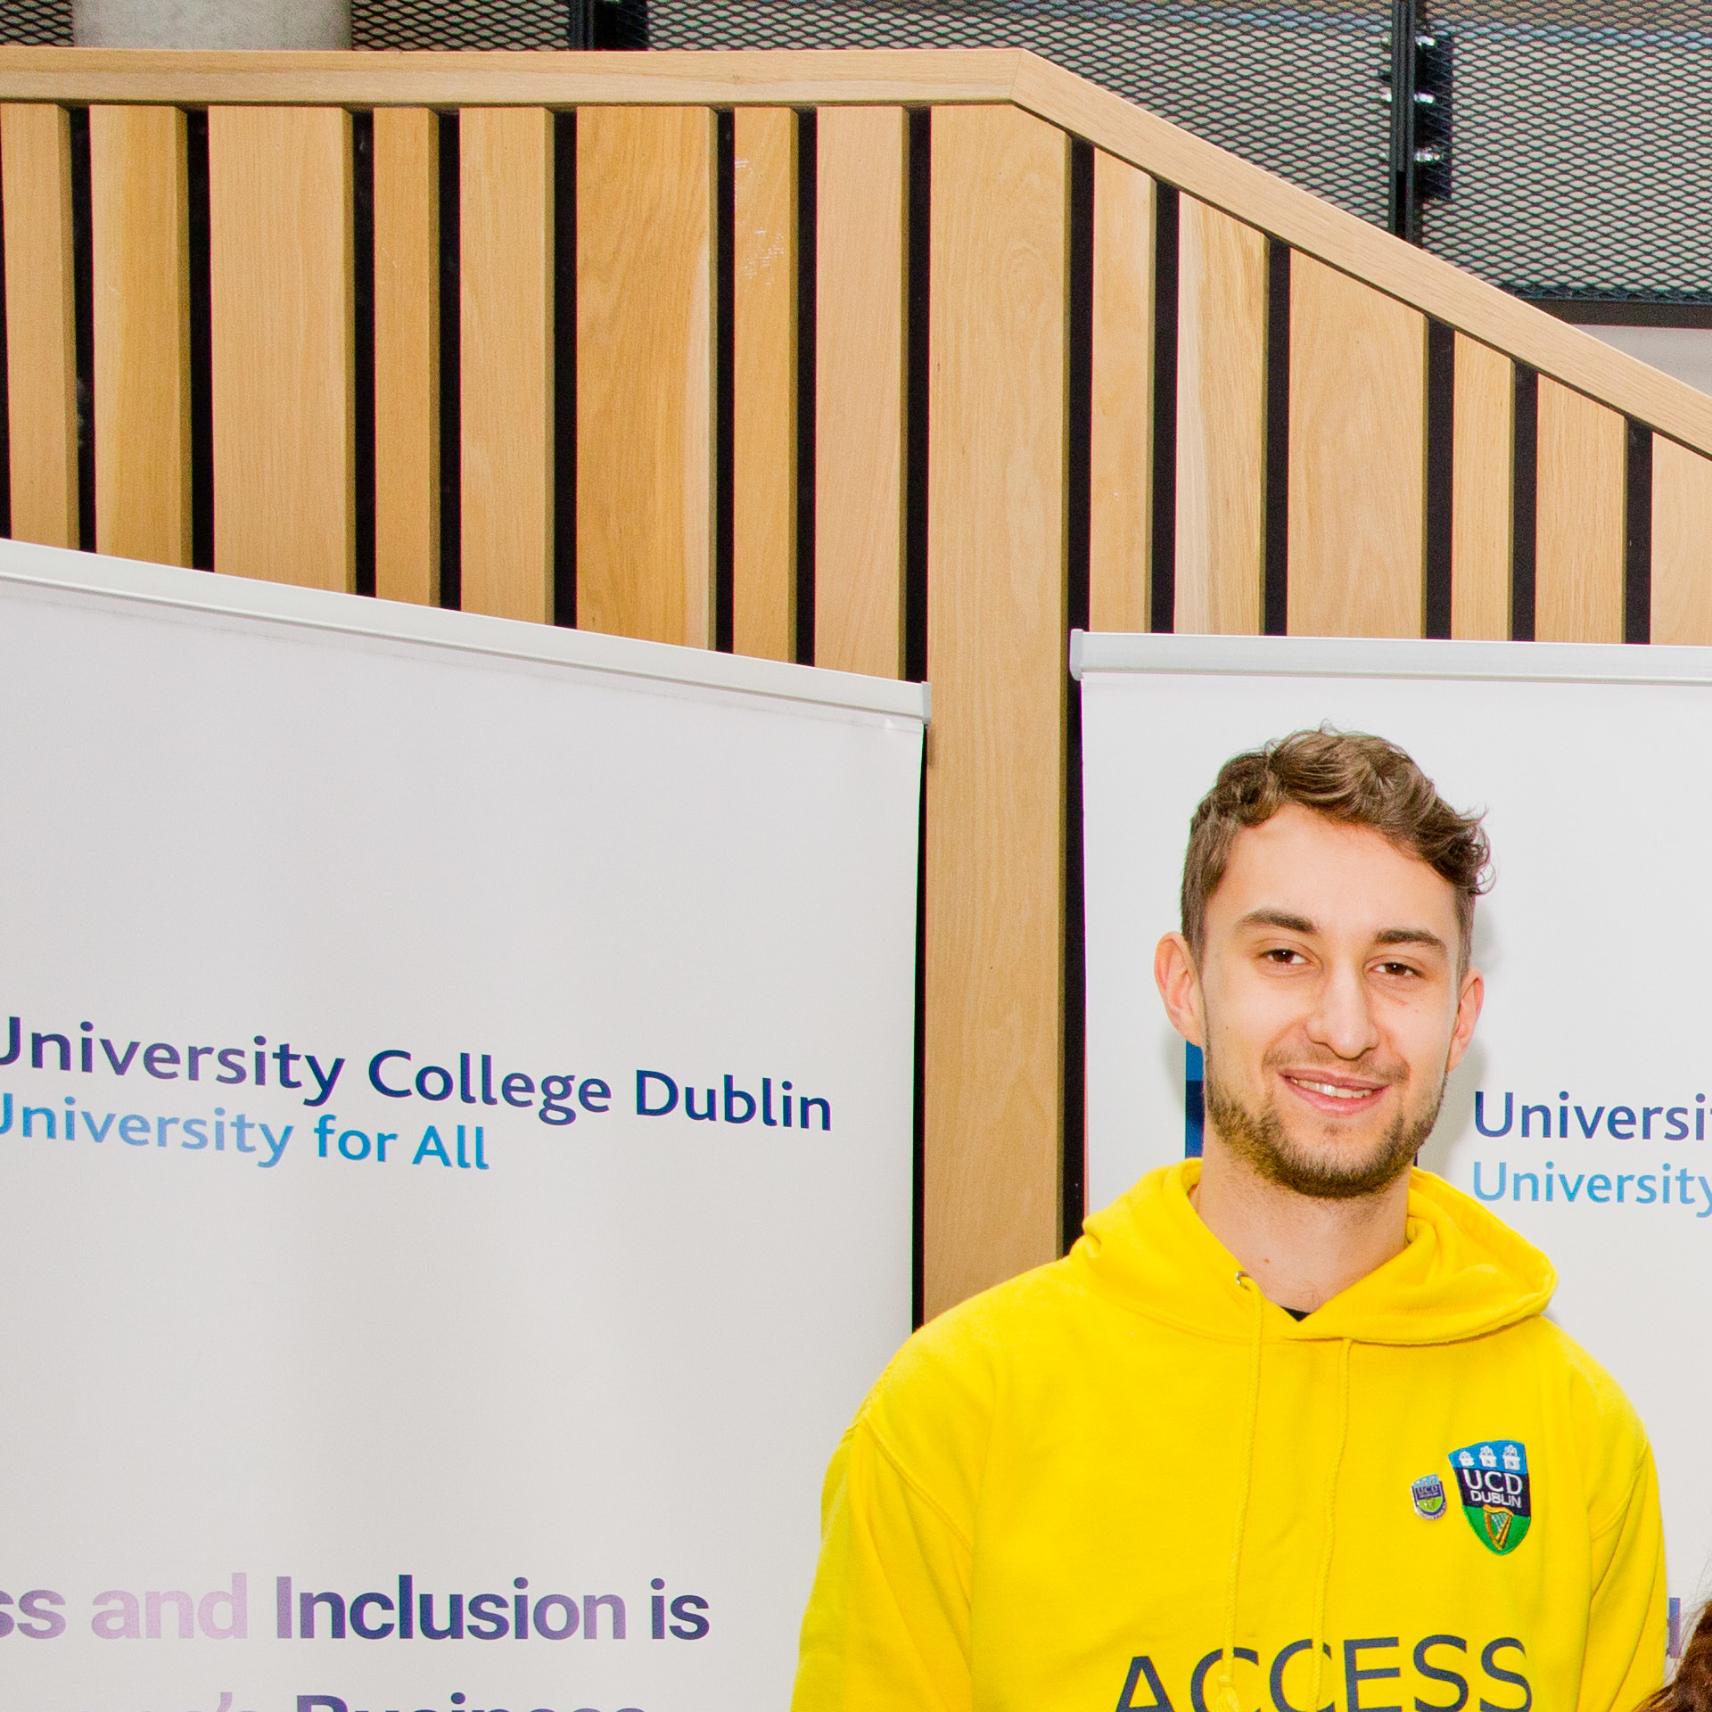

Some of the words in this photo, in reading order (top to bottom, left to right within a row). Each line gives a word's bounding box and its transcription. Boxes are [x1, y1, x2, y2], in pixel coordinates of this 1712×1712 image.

[368, 1050, 611, 1127] College
[636, 1070, 830, 1131] Dublin
[314, 1115, 388, 1163] for
[413, 1125, 488, 1169] All
[1462, 1469, 1522, 1495] UCD
[1471, 1490, 1522, 1508] DUBLIN
[91, 1572, 248, 1642] and
[277, 1574, 625, 1640] Inclusion
[651, 1578, 709, 1640] is
